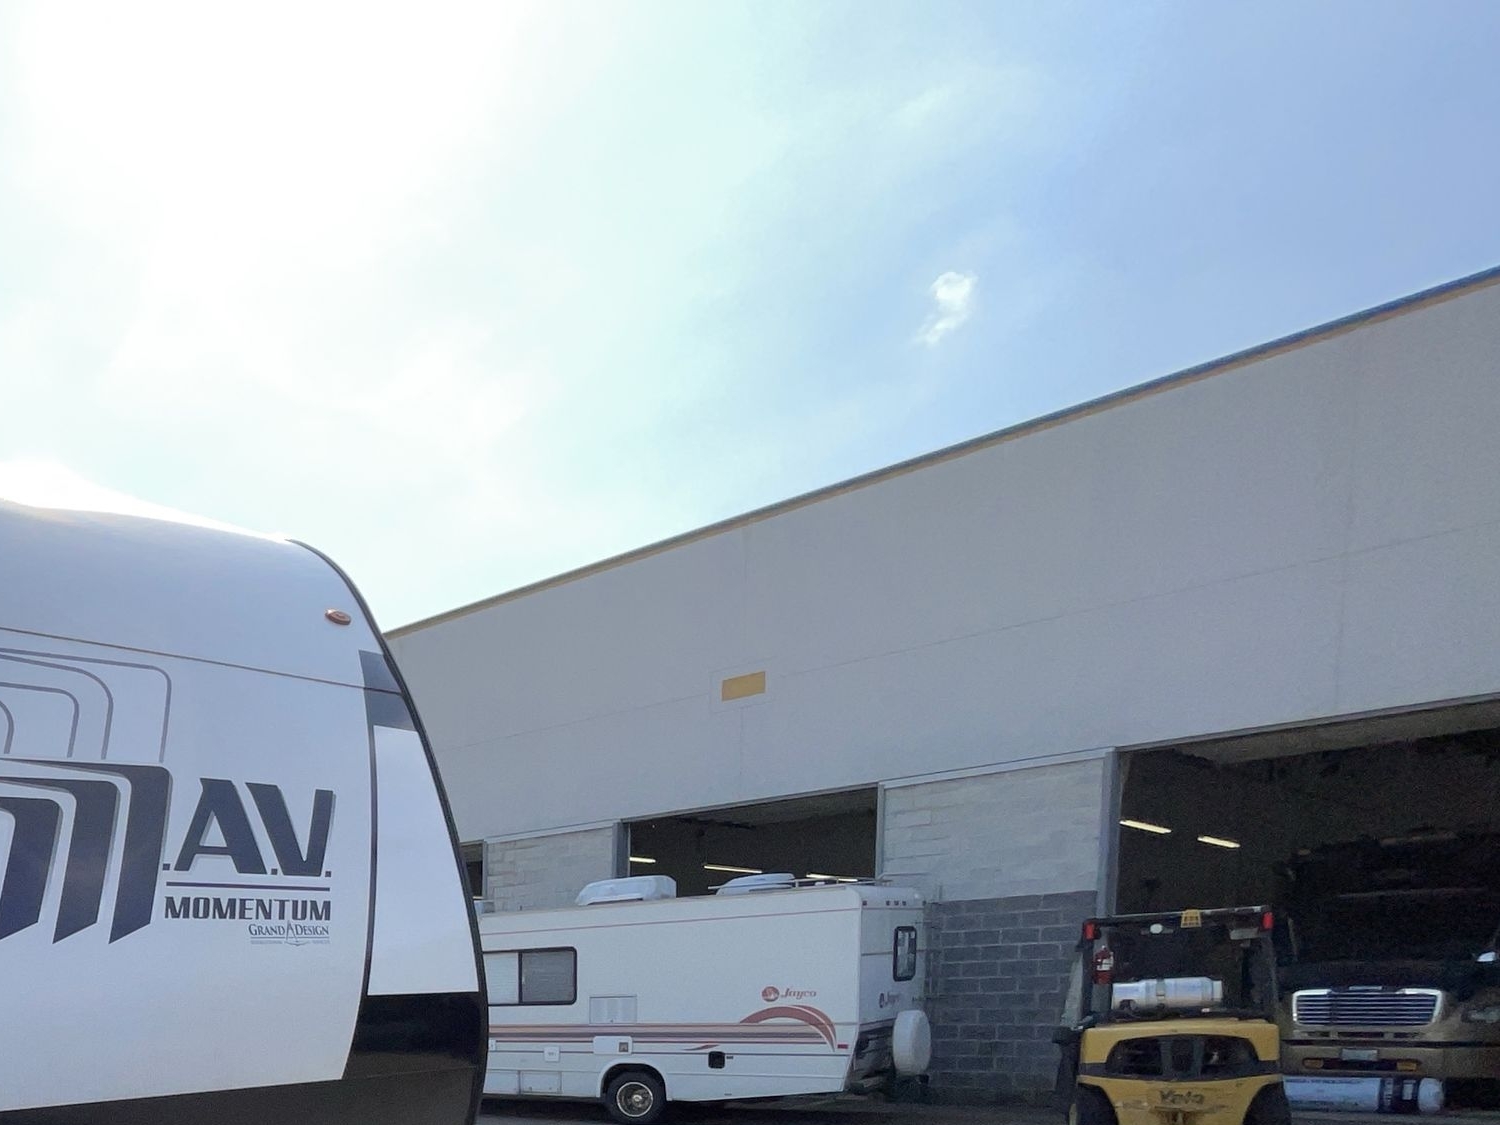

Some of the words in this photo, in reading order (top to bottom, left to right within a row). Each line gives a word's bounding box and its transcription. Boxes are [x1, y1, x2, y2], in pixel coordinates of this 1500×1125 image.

[164, 896, 331, 921] MOMENTUM
[248, 923, 285, 936] GRAND
[294, 923, 330, 936] DESIGN
[780, 988, 817, 1000] Jayco
